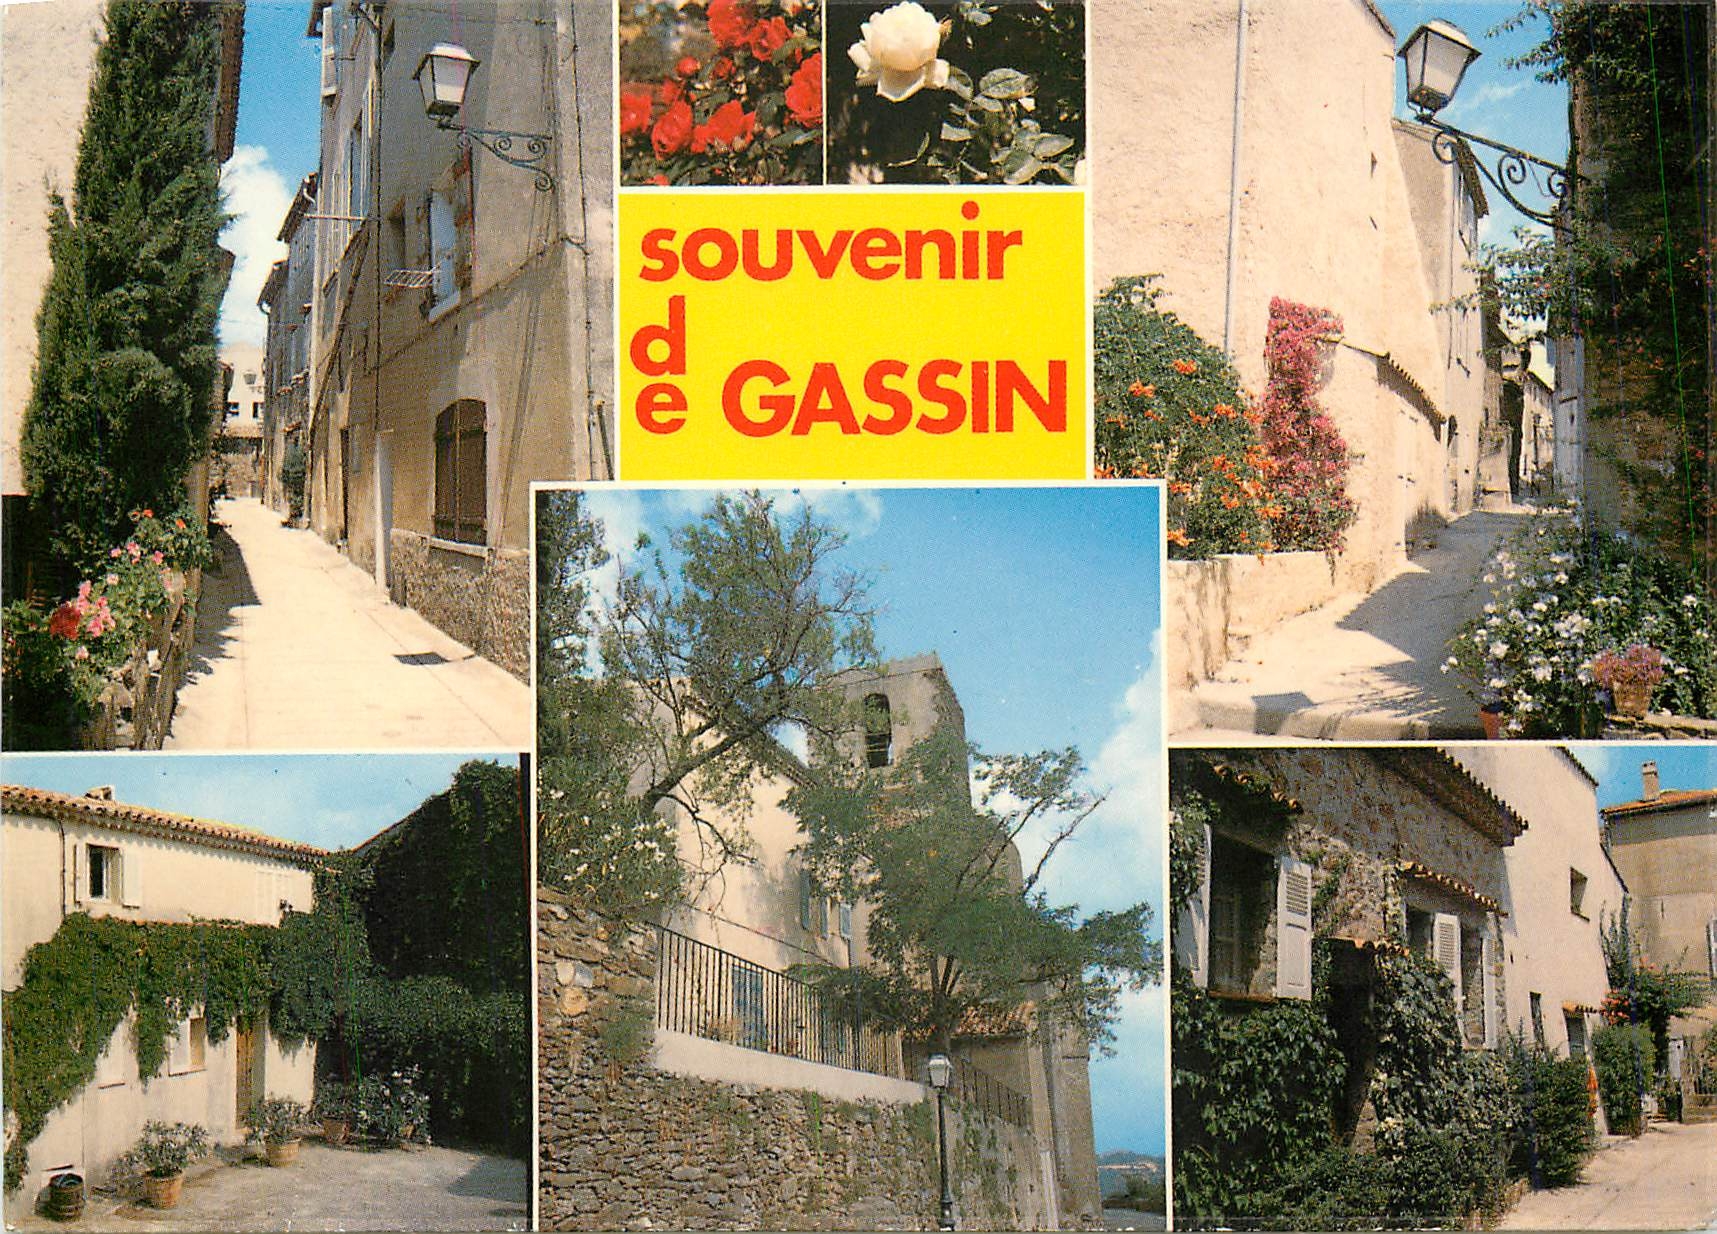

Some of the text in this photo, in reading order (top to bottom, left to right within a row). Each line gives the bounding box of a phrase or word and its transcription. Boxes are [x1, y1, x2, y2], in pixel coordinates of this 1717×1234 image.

[639, 200, 1023, 282] souvenir
[629, 294, 689, 435] de
[721, 358, 1068, 438] GASSIN
